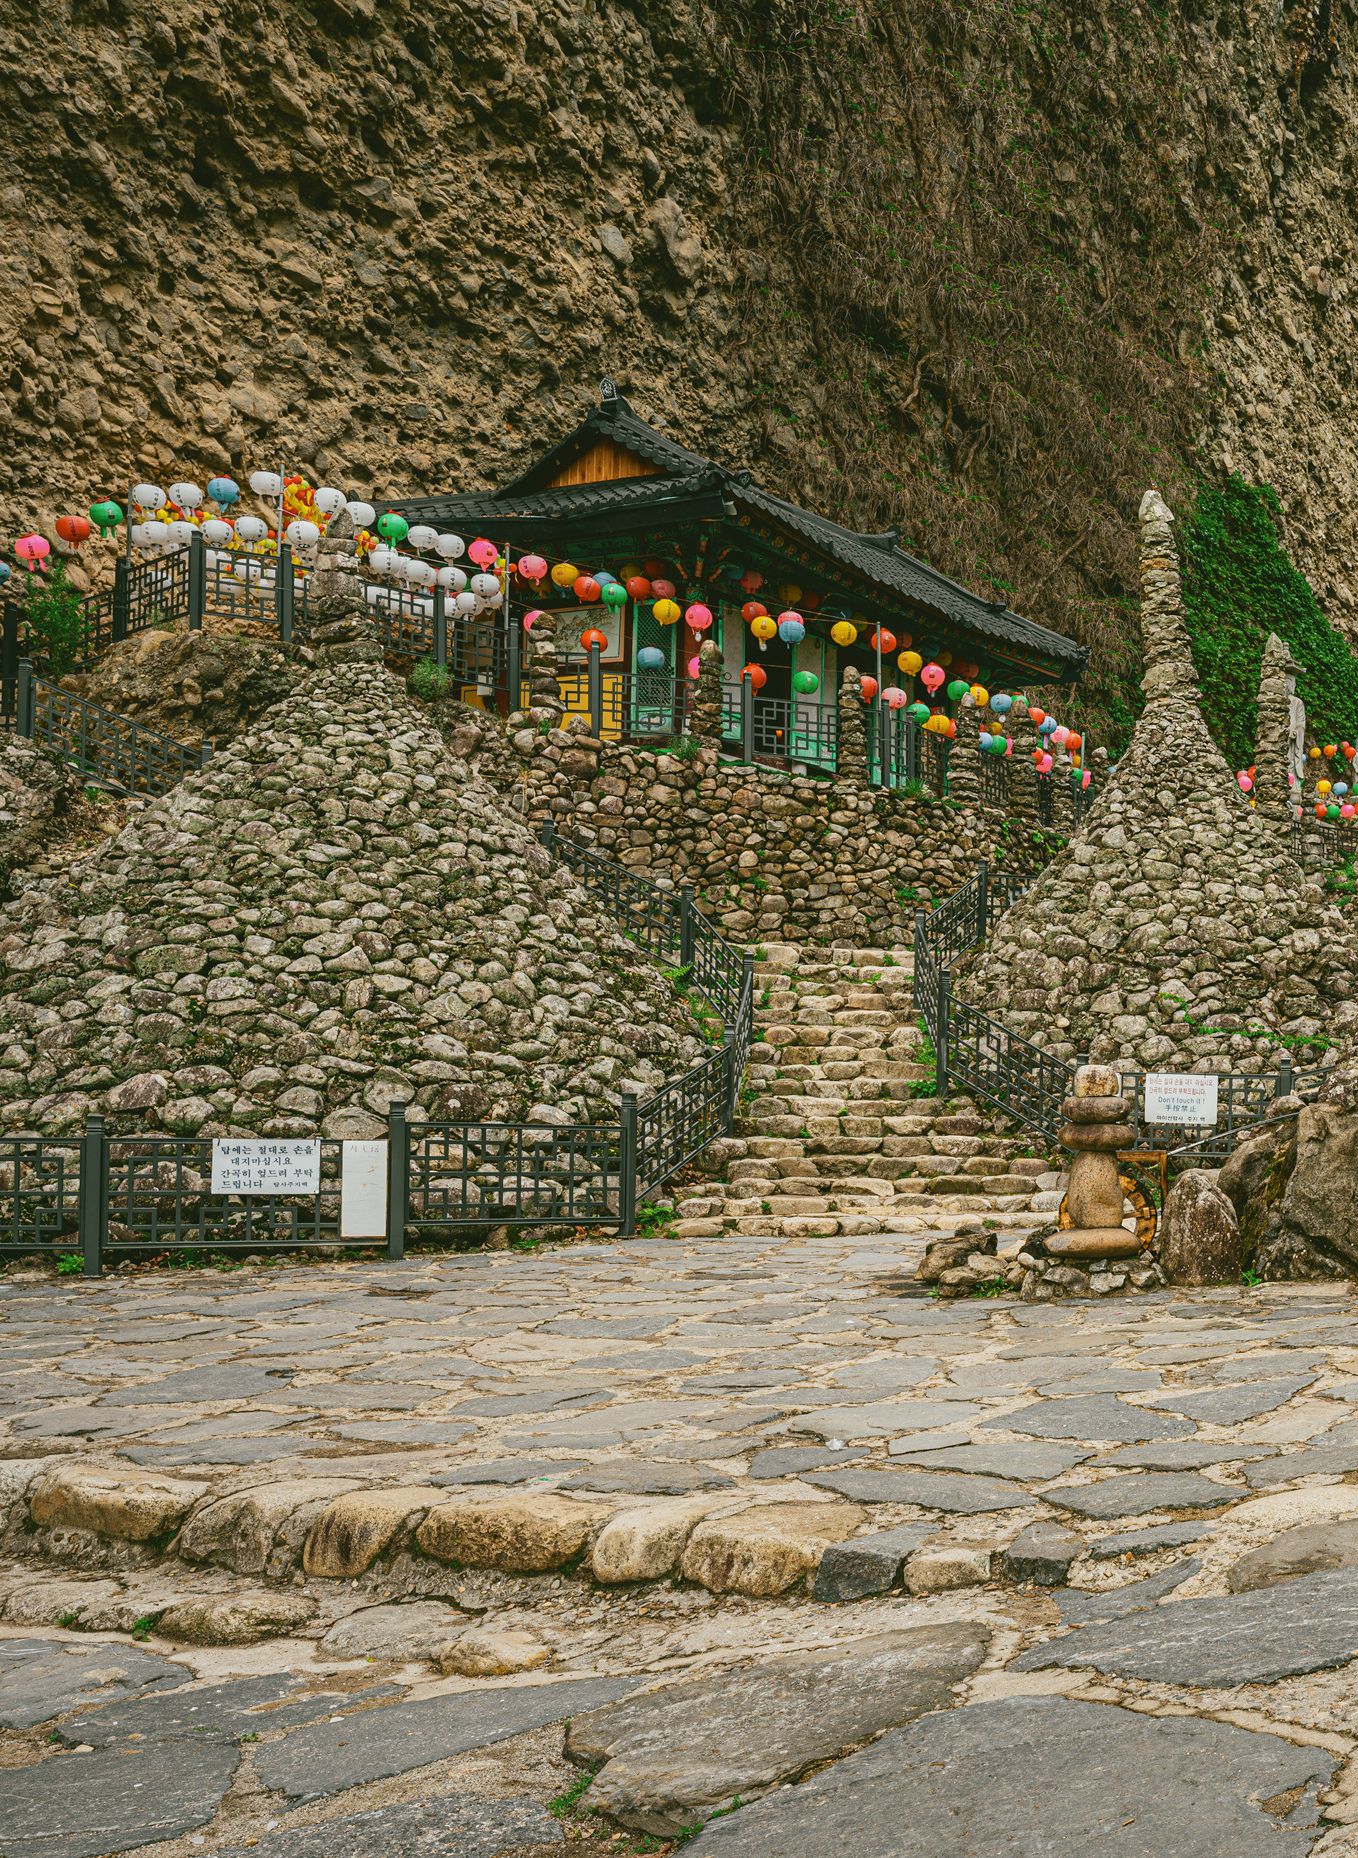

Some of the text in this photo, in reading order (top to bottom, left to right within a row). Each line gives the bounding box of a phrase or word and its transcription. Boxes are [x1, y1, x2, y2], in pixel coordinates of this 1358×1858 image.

[221, 1145, 313, 1155] 탑에는 절대로 손을
[221, 1168, 313, 1178] 간곡히 엎드려 부탁
[221, 1180, 263, 1189] 드립니다
